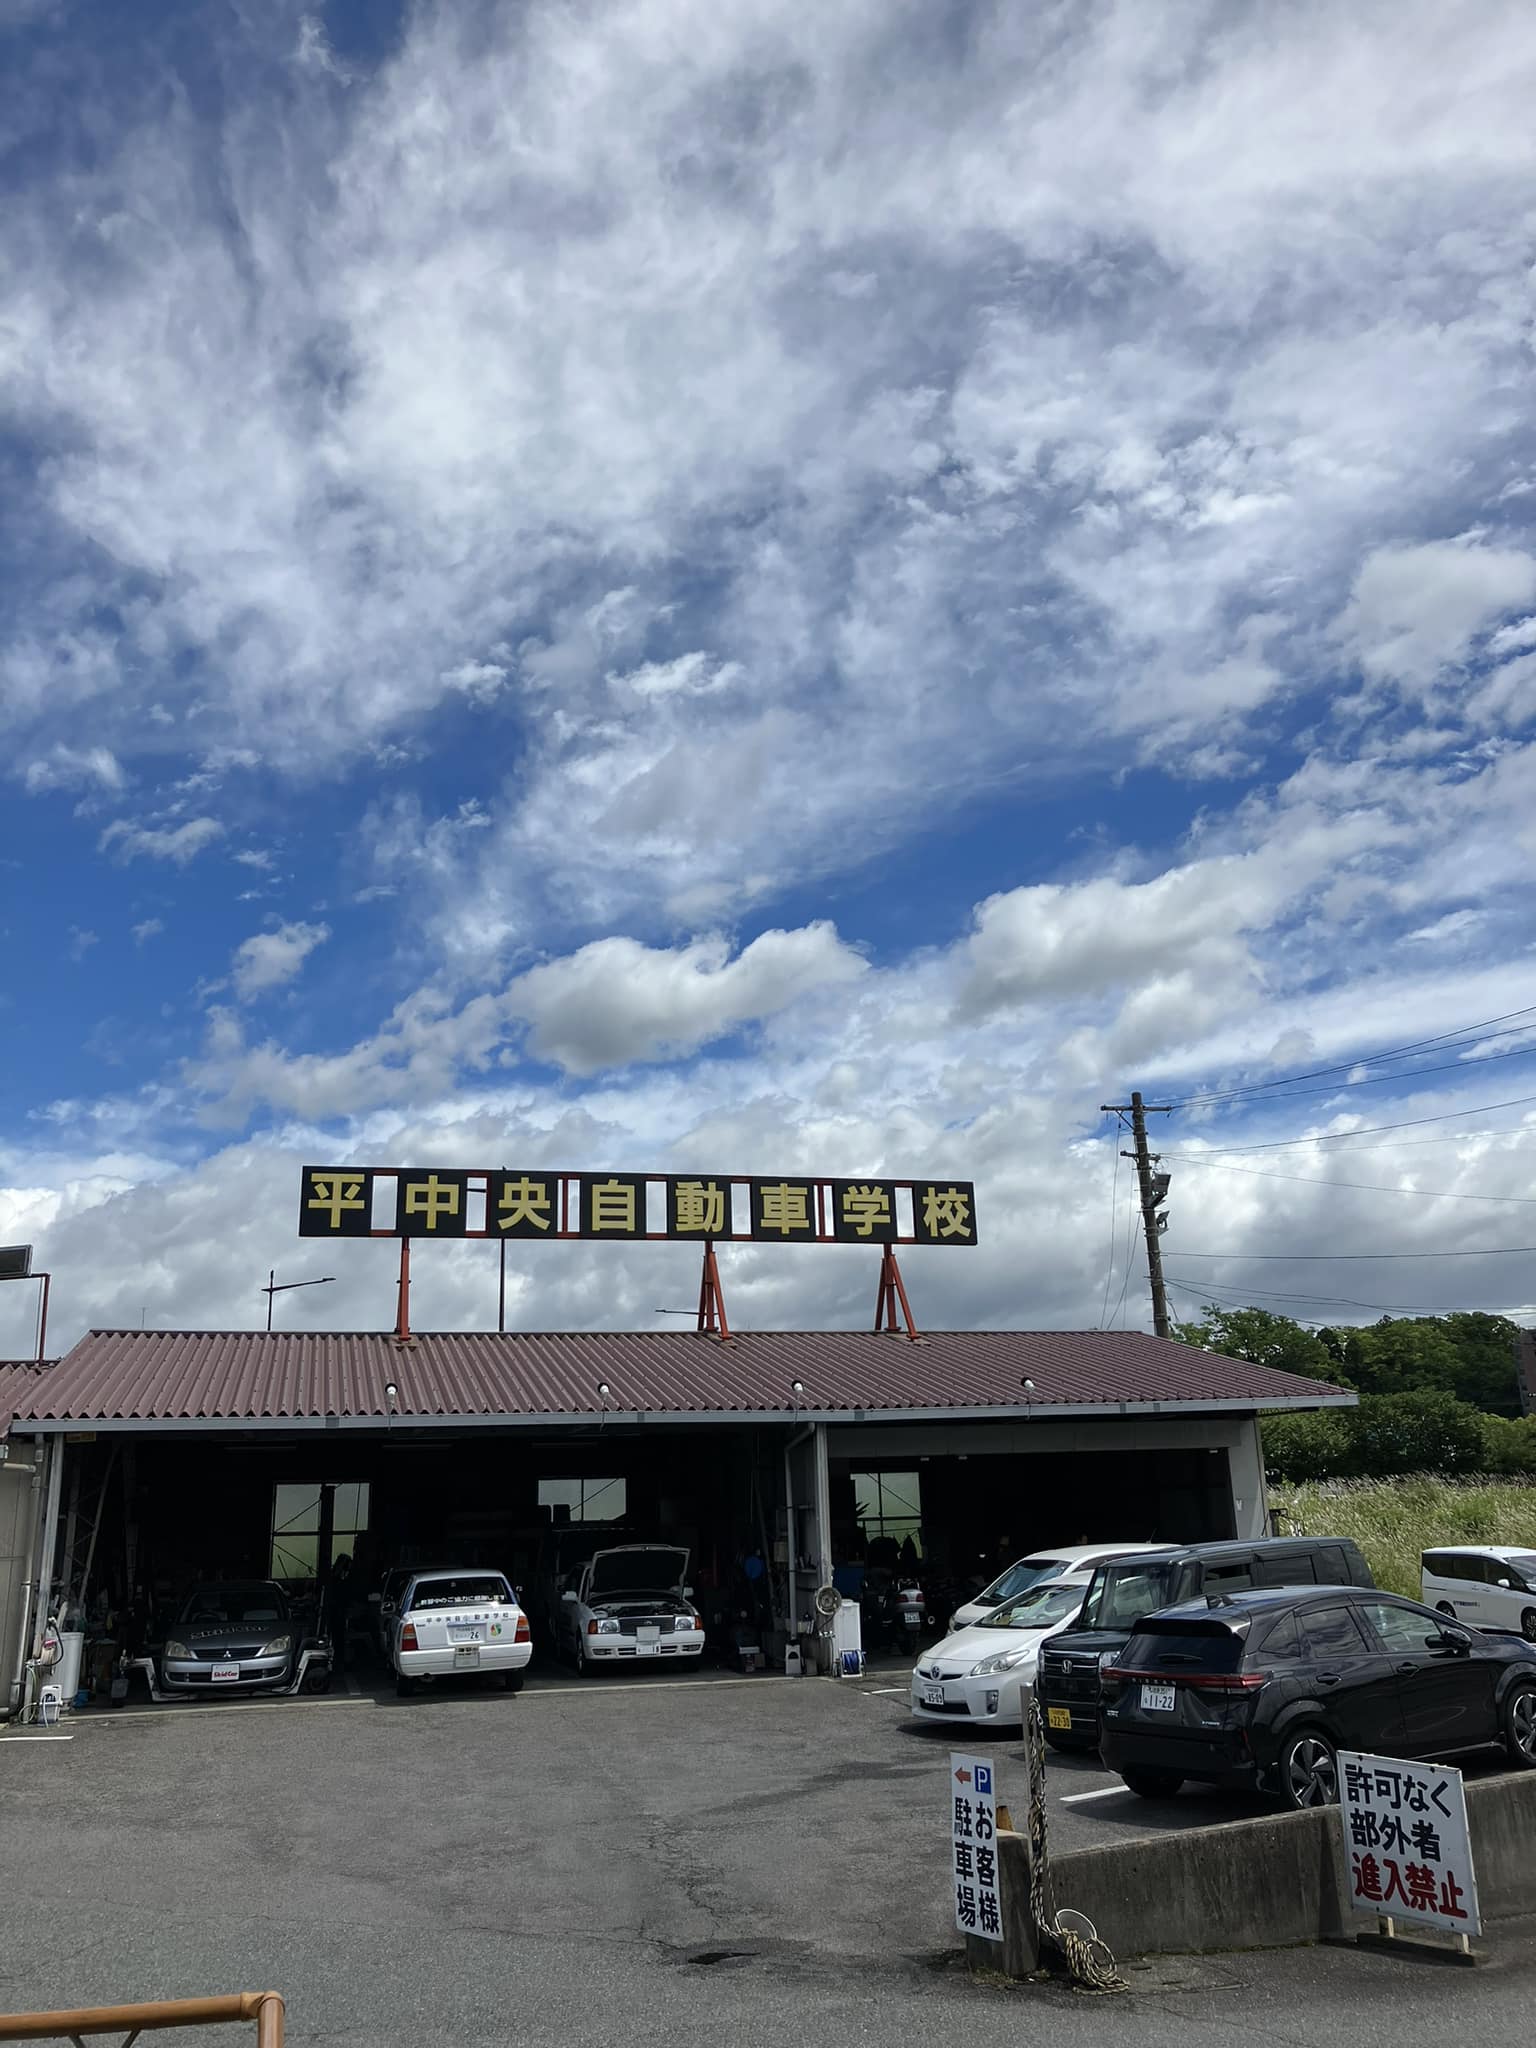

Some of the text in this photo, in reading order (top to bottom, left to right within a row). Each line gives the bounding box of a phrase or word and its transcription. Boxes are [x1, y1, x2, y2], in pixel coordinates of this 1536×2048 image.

[308, 1172, 971, 1238] 平中央自動車学校
[1149, 1695, 1173, 1709] 11-22
[977, 1768, 988, 1791] P
[1345, 1763, 1452, 1818] 許可なく
[954, 1797, 976, 1927] 駐車場
[1350, 1808, 1441, 1862] 部外者
[975, 1801, 1000, 1934] お客様
[1352, 1851, 1468, 1919] 進入禁止
